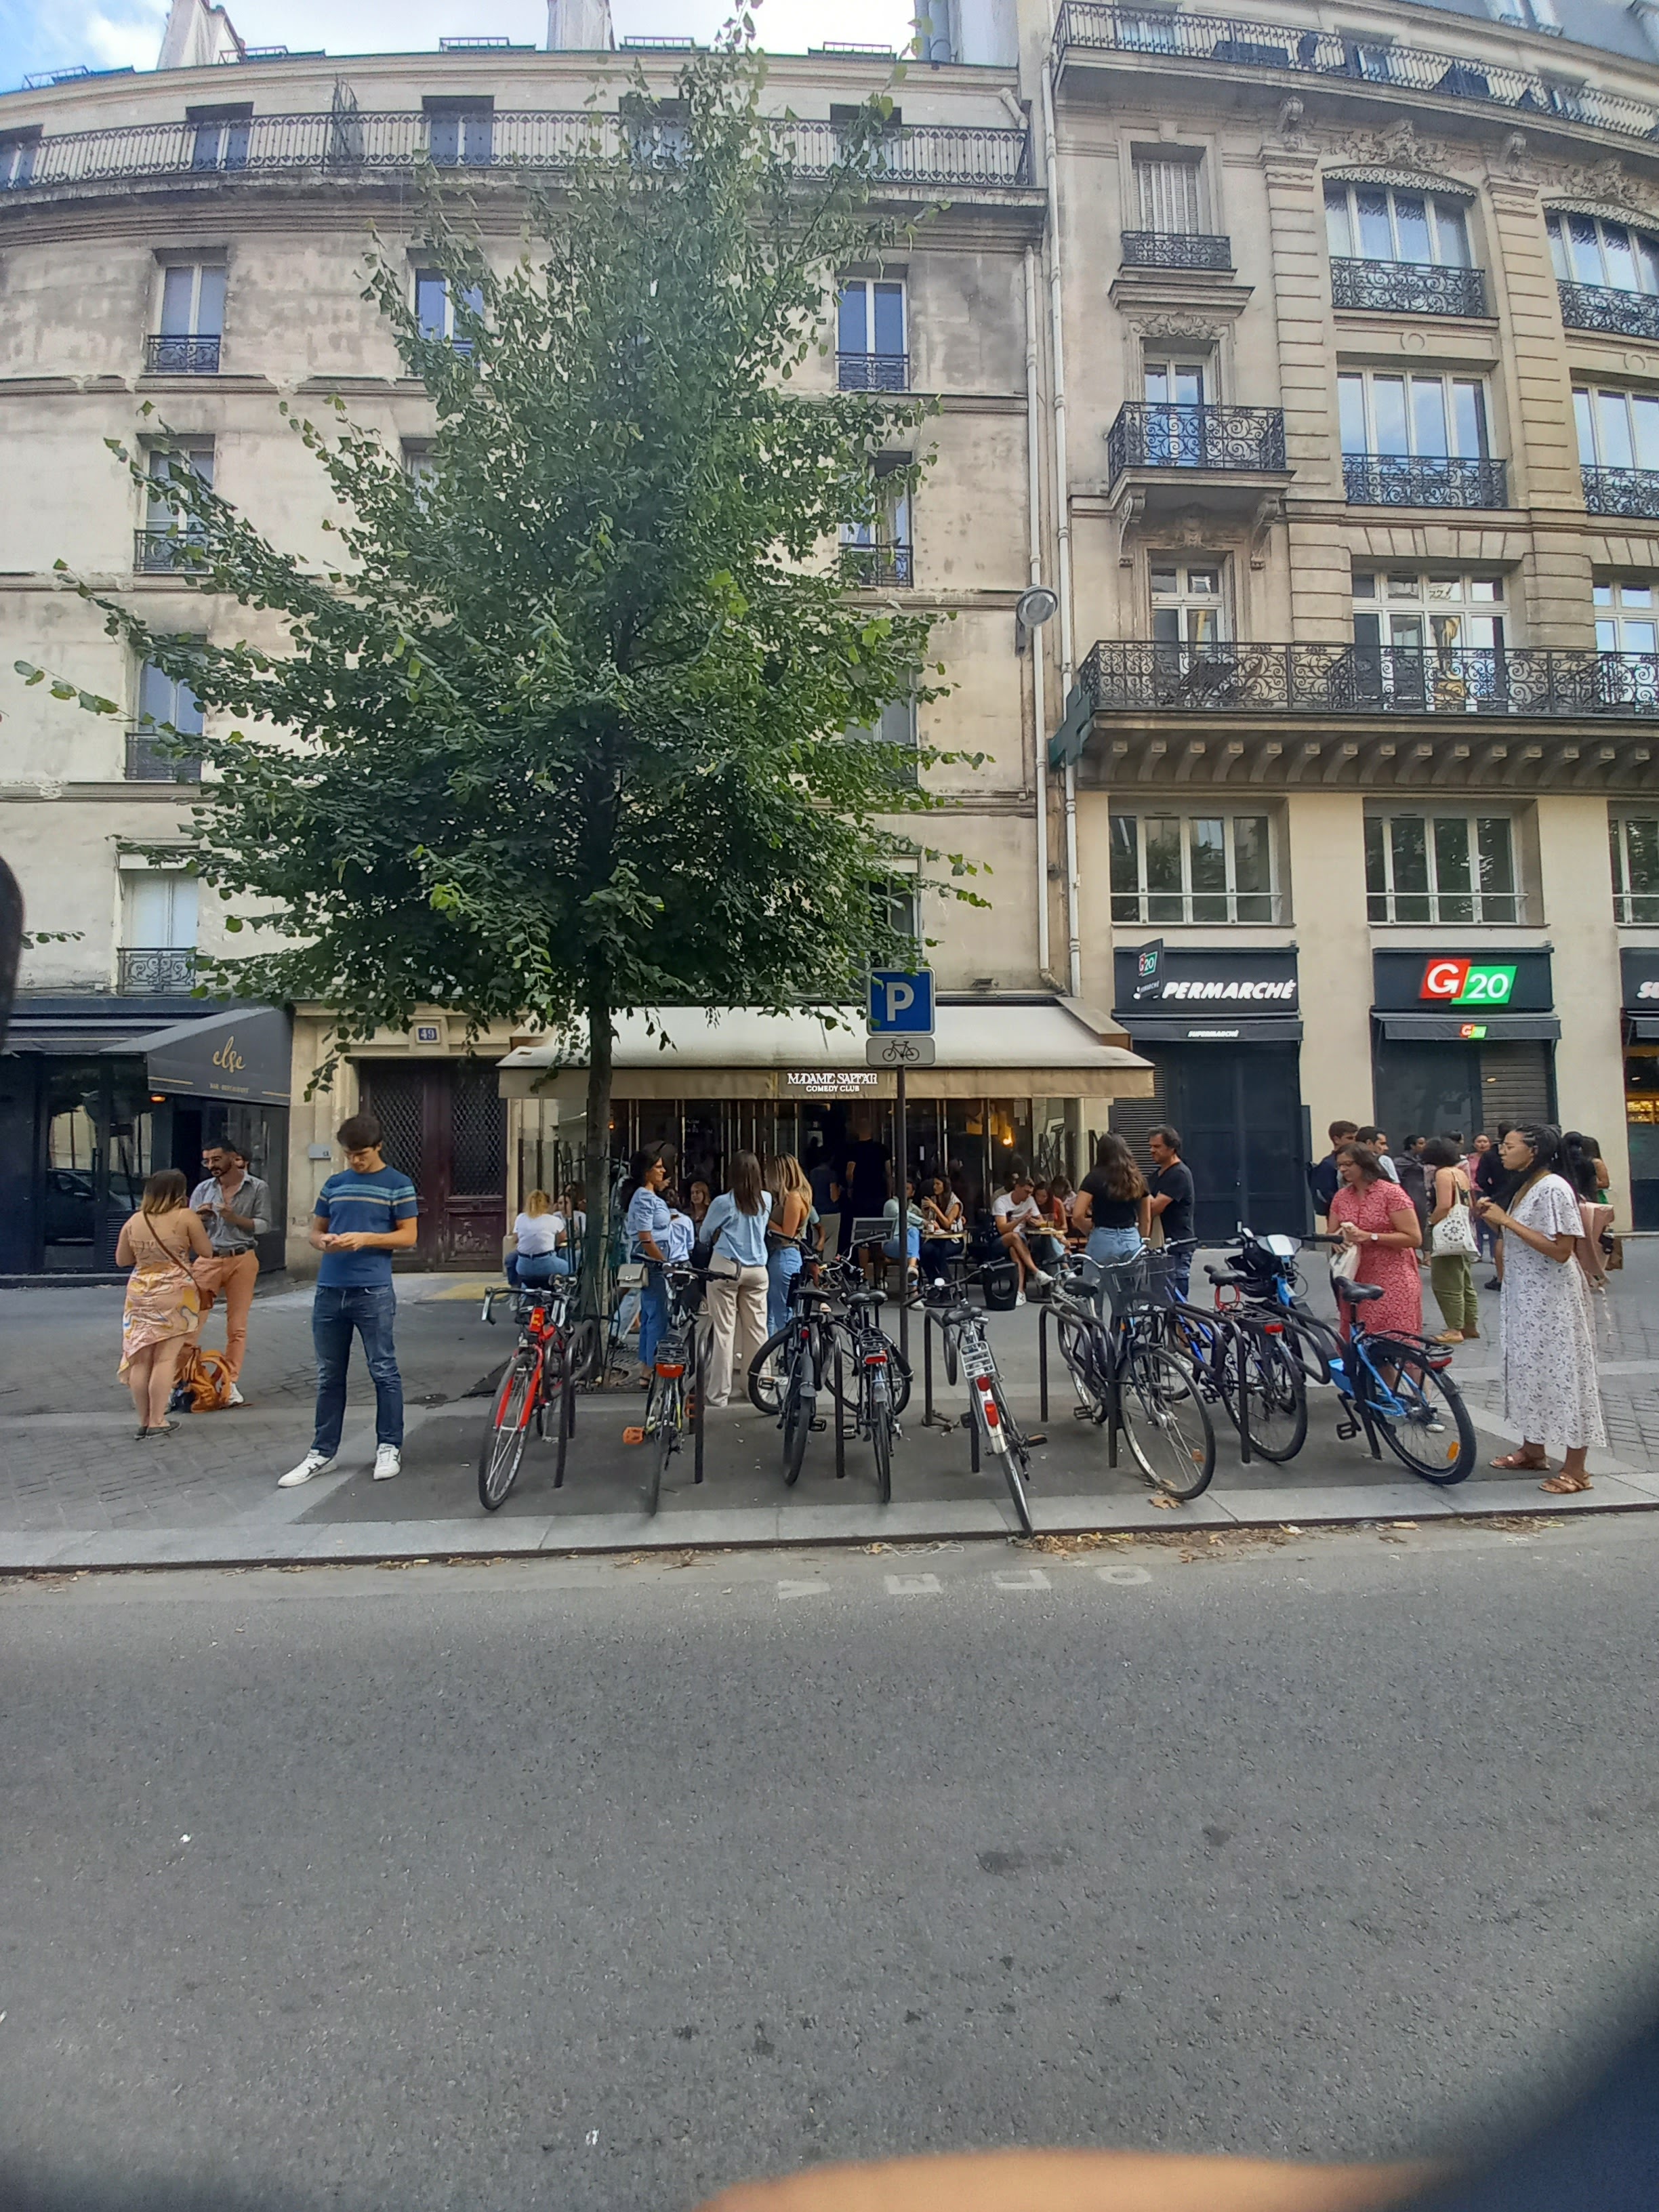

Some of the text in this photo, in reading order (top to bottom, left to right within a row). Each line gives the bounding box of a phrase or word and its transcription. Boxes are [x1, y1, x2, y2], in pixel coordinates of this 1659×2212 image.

[1133, 979, 1296, 1000] PERMARCHÉ
[886, 982, 914, 1021] P
[420, 1029, 435, 1040] 49
[213, 1036, 246, 1073] else
[787, 1073, 836, 1085] MADAME
